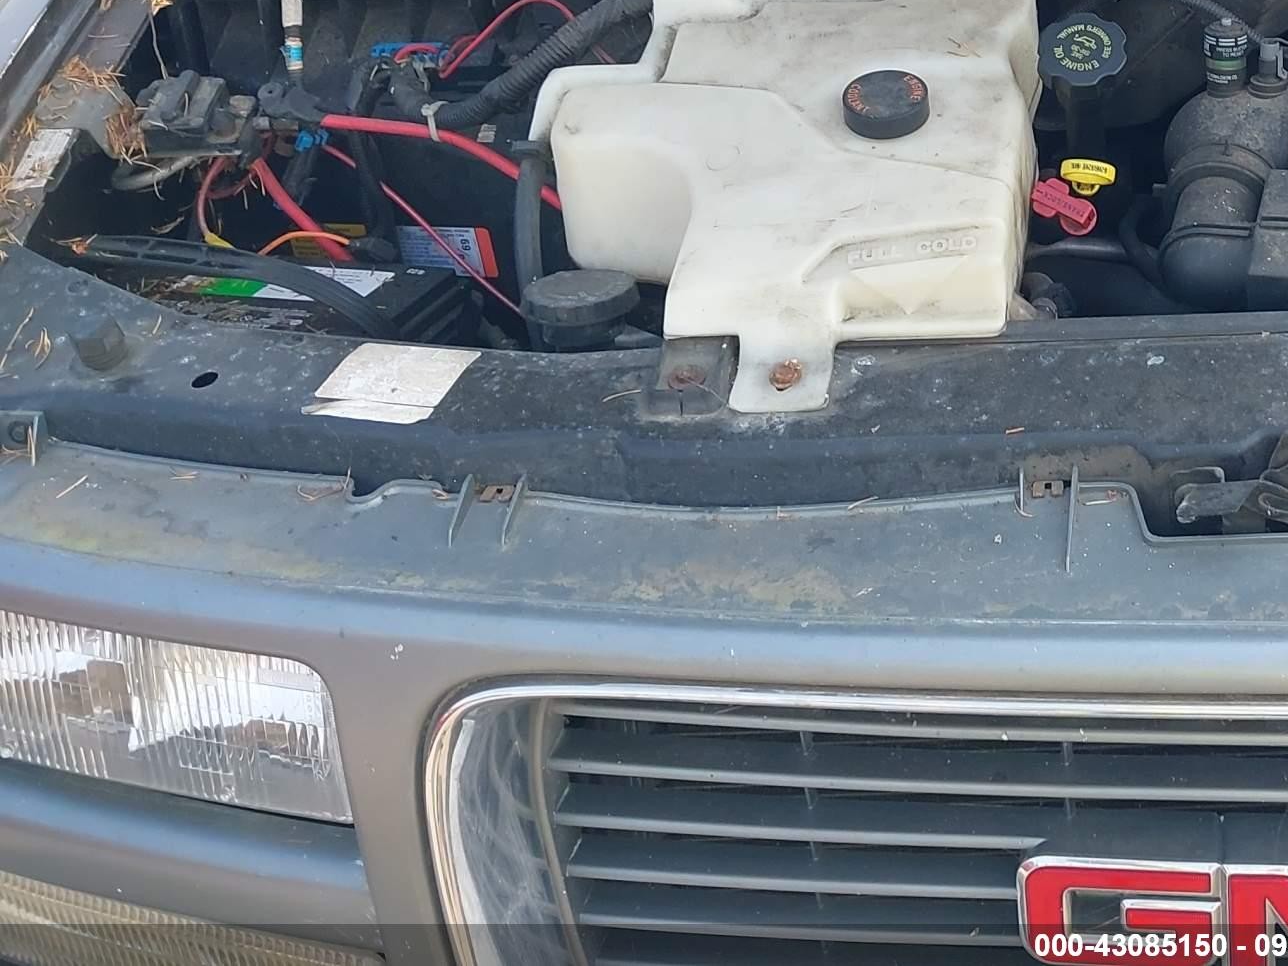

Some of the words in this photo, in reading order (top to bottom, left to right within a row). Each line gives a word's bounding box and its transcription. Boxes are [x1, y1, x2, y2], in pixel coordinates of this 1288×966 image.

[1056, 23, 1085, 40] MANUAL
[1053, 44, 1065, 59] OIL
[1060, 57, 1100, 71] ENGINE
[916, 236, 978, 253] COLD
